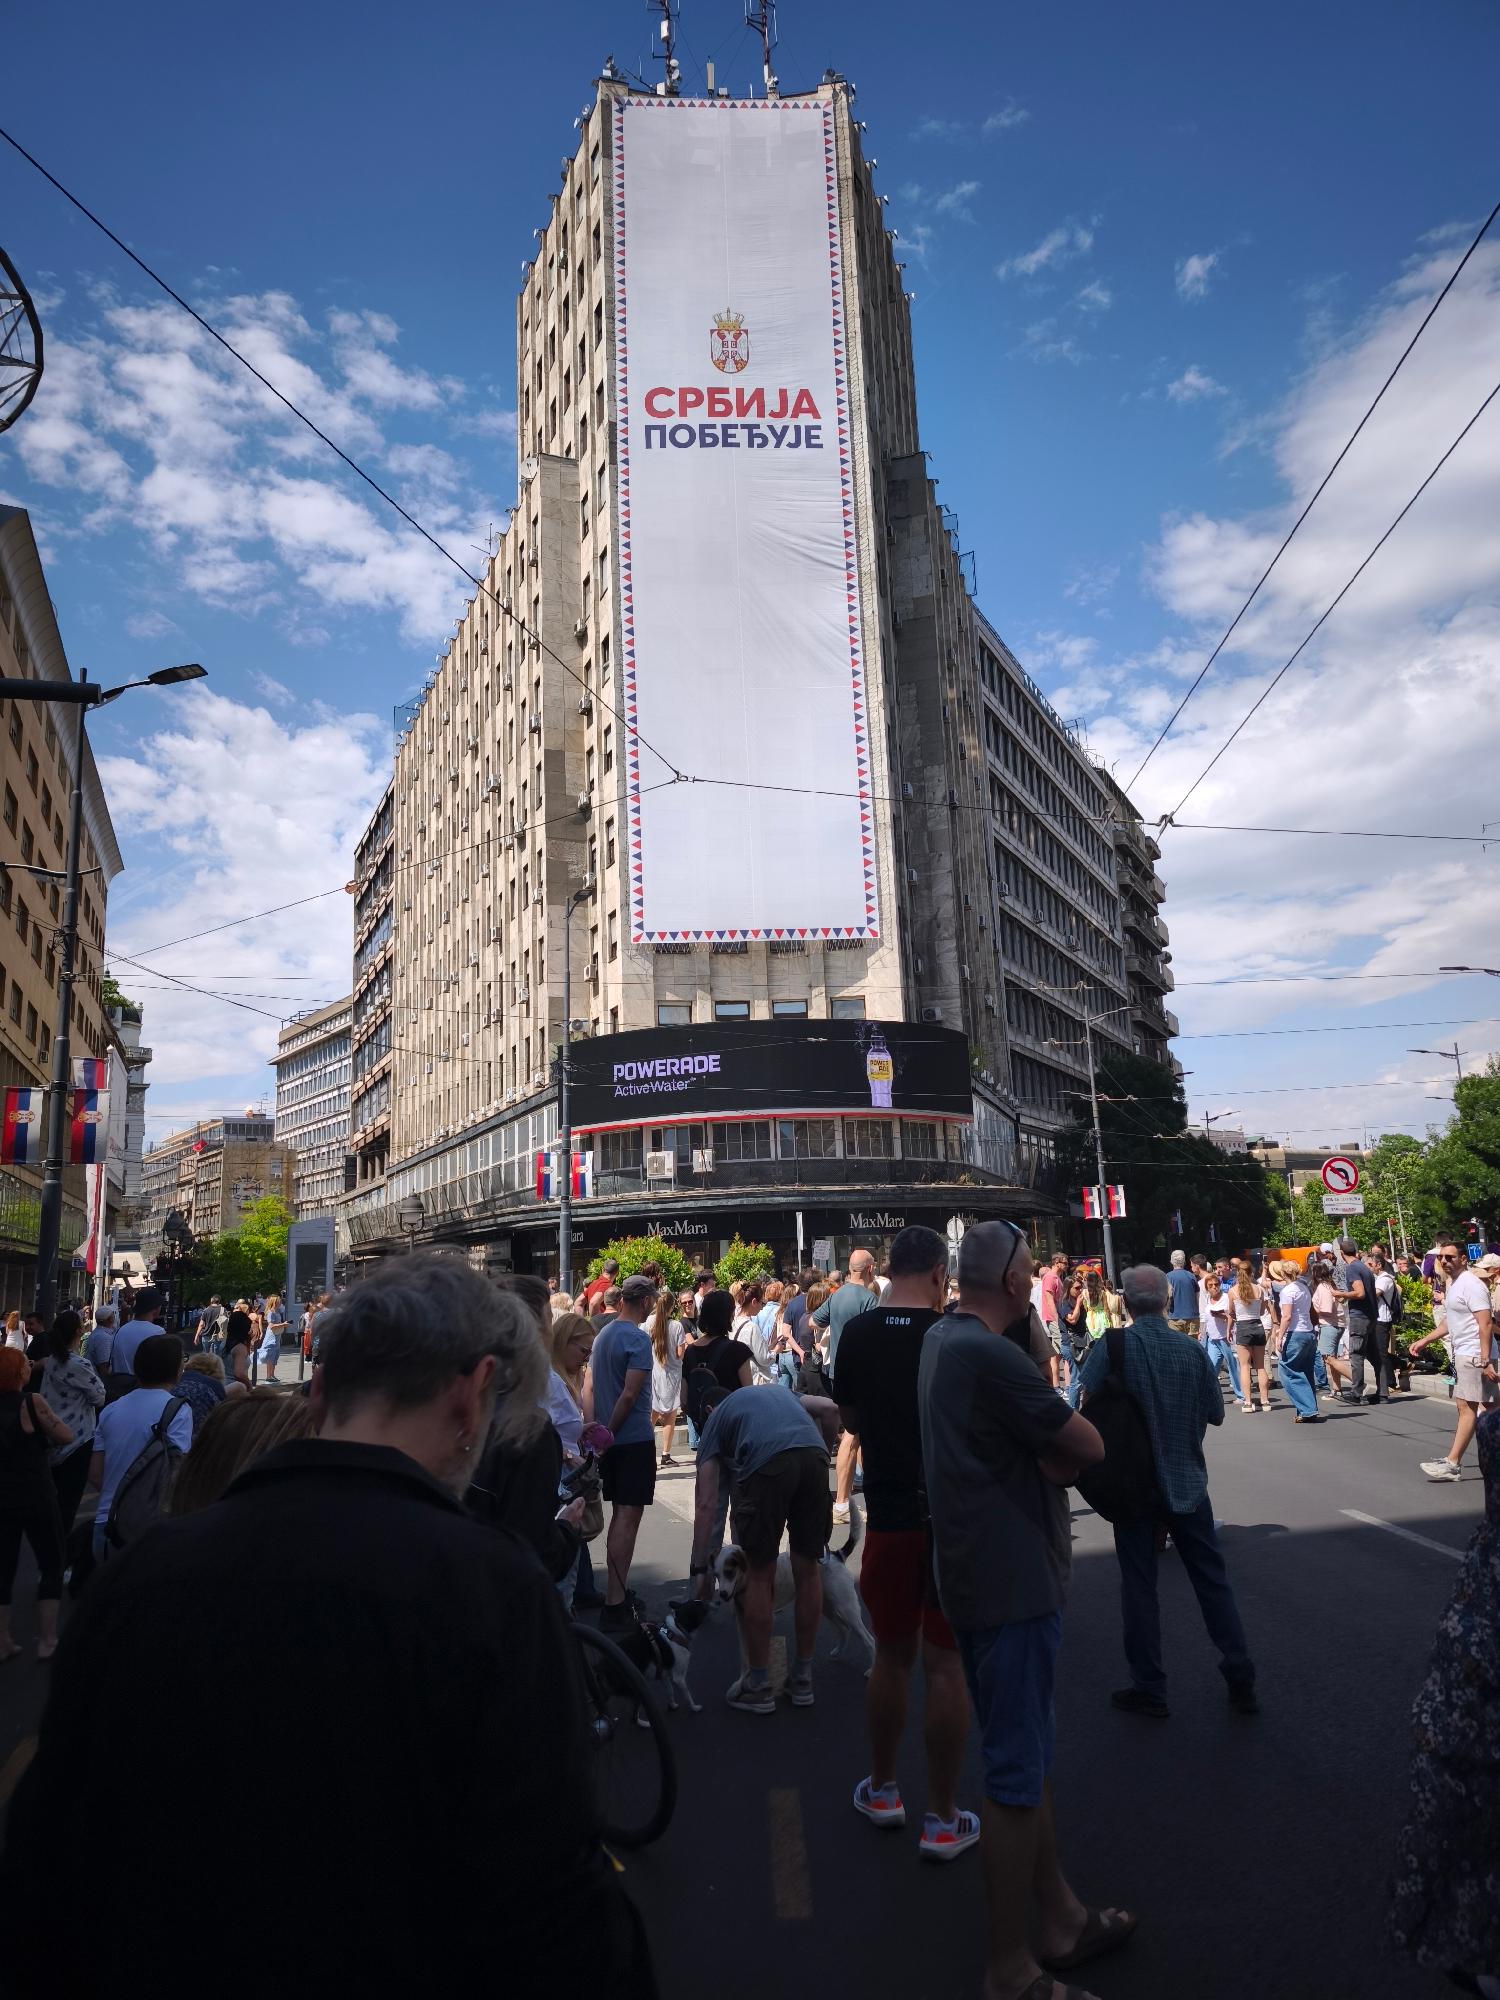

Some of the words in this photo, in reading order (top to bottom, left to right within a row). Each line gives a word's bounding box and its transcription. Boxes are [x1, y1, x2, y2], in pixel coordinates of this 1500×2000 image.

[644, 386, 822, 420] СРБИЈА
[644, 423, 824, 449] ПОБЕЂУЈЕ
[613, 1054, 721, 1083] POWERADE
[647, 1219, 708, 1237] MaxMara
[849, 1212, 905, 1229] MaxMara
